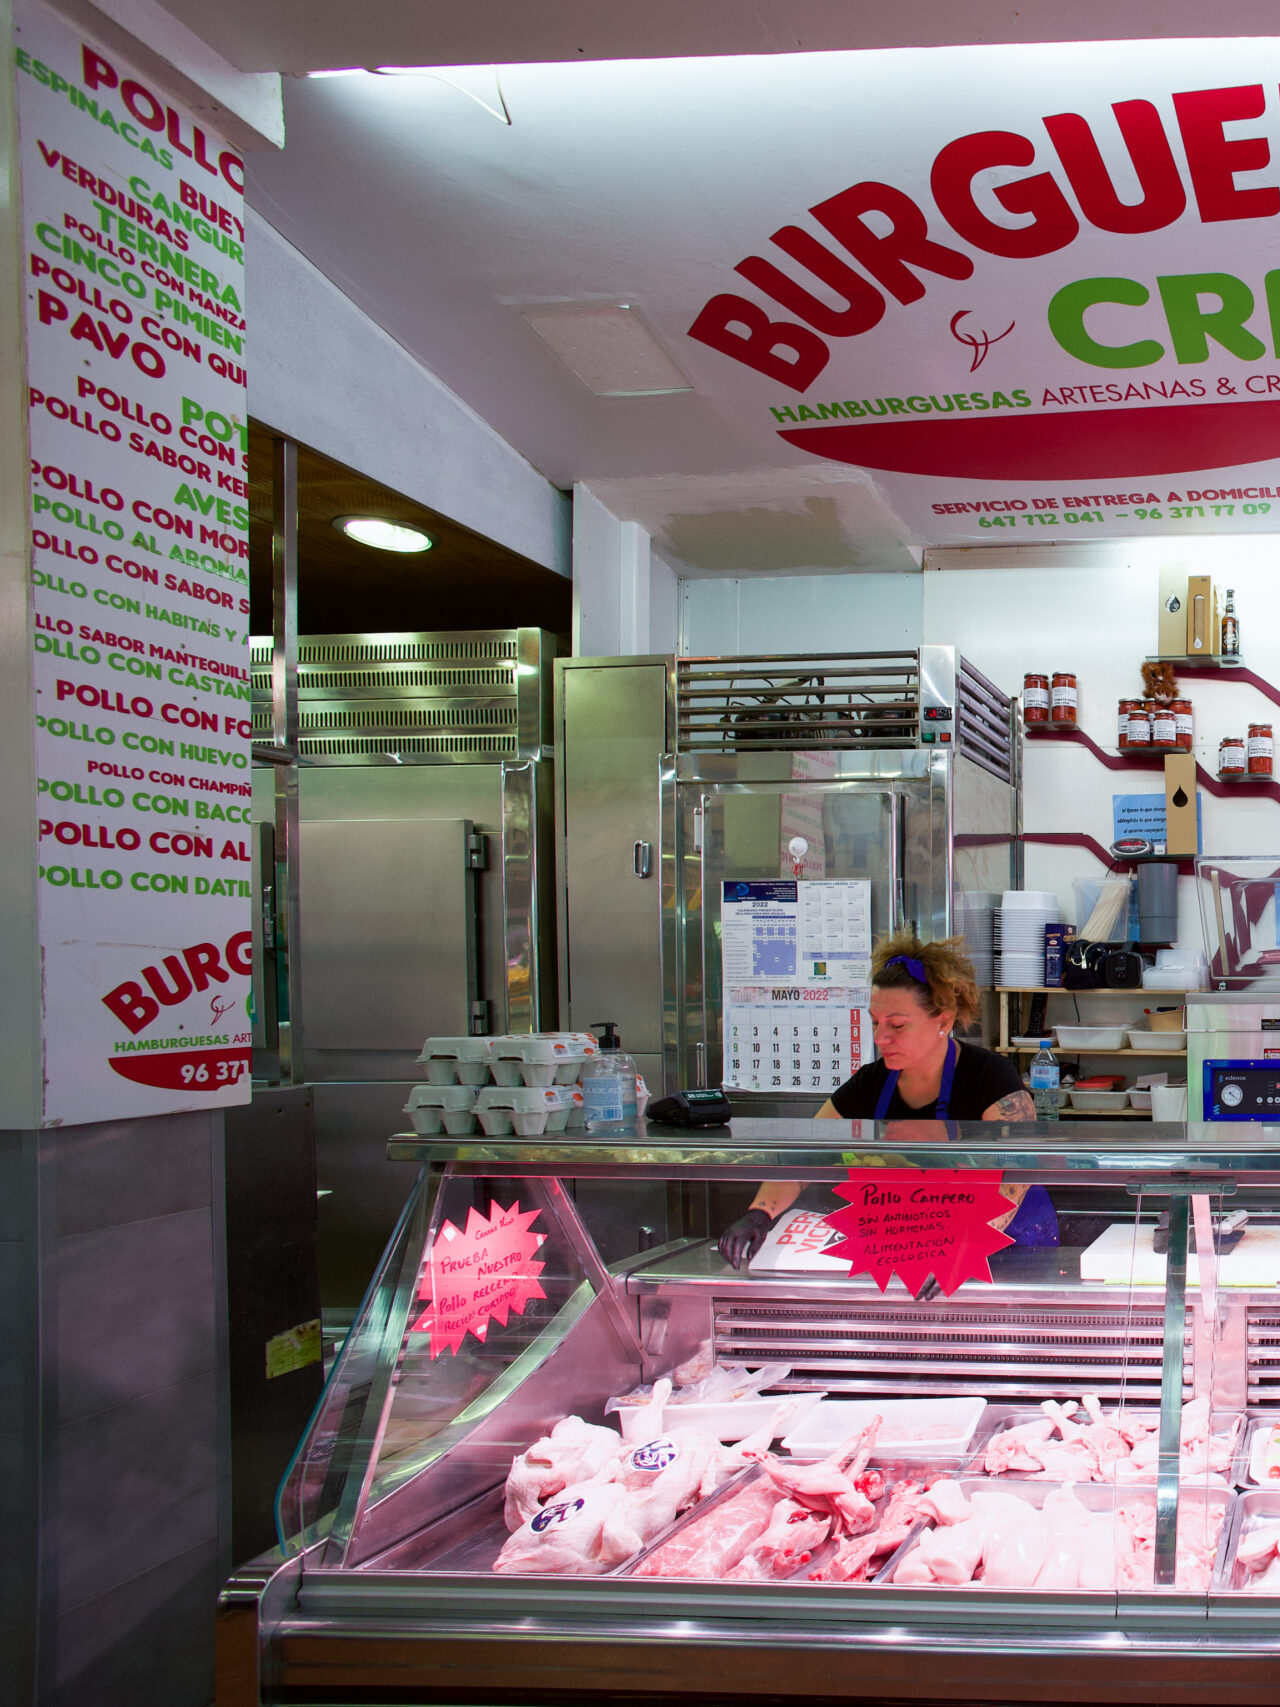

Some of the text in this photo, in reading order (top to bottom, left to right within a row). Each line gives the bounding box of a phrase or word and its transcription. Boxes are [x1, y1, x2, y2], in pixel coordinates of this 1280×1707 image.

[15, 47, 173, 171] ESPINACAS
[36, 137, 189, 252] VERDURAS
[35, 221, 146, 299] CINCO
[63, 212, 184, 297] POLLO CON
[93, 200, 242, 314] TERNERA
[30, 253, 201, 363] POLLO CON
[37, 289, 166, 379] PAVO
[768, 389, 1032, 424] HAMBURGUESAS
[1042, 377, 1207, 408] ARTESANAS
[1218, 376, 1237, 395] &
[29, 386, 212, 483] POLLO SABOR
[78, 375, 235, 466] POLLO CON
[132, 499, 193, 539] CON
[173, 482, 249, 531] AVES
[932, 492, 1182, 515] SERVICIO DE ENTREGA A
[978, 502, 1271, 528] 647 712 041 96 371 77 09
[33, 493, 162, 555] POLLO AL
[105, 554, 234, 610] CON SABOR
[93, 588, 237, 642] CON HABITAS Y
[79, 625, 145, 654] SABOR
[107, 652, 162, 681] CON
[56, 679, 218, 732] POLLO CON
[122, 730, 248, 770] CON HUEVO
[87, 760, 185, 787] POLLO CON
[132, 792, 189, 817] CON
[39, 818, 213, 858] POLLO CON
[130, 871, 188, 894] CON
[771, 989, 829, 1000] MAYO 2022
[114, 1033, 229, 1053] HAMBURGUESAS
[181, 1064, 209, 1083] 96
[858, 1214, 878, 1226] SIN
[858, 1227, 878, 1238] SIN
[440, 1248, 488, 1274] PRUEBA
[477, 1252, 522, 1280] NUESTRO
[864, 1237, 955, 1255] ALIMENTACION
[877, 1249, 947, 1266] ECOLOGICA
[477, 1288, 516, 1316] CORTADO
